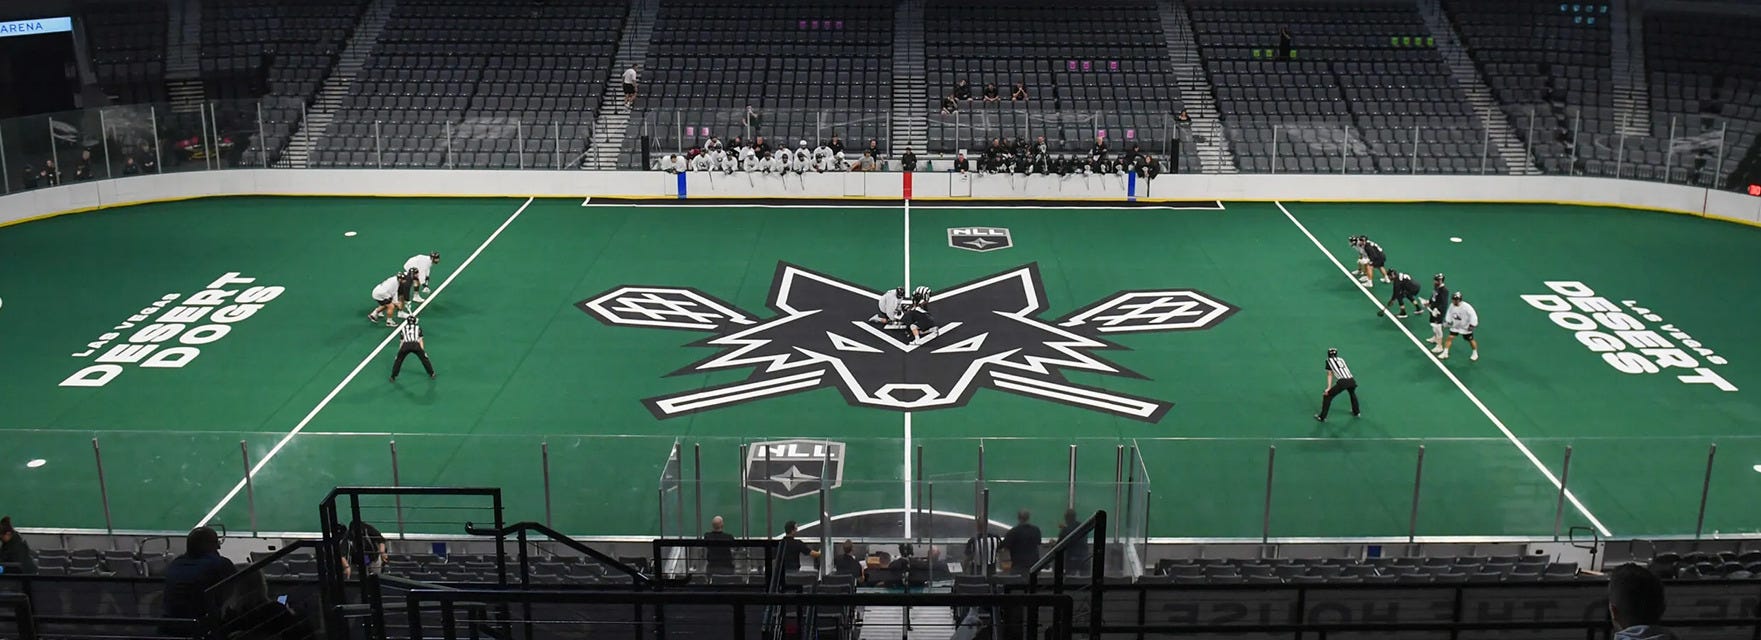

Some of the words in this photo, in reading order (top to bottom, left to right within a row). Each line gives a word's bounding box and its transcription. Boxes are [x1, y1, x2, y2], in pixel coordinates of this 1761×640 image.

[1, 22, 43, 33] ARENA
[58, 272, 256, 387] DESERT
[72, 332, 120, 357] LAS
[114, 293, 181, 330] VEGAS
[139, 286, 285, 369] DOGS
[1520, 294, 1659, 374] DOGS
[1544, 281, 1738, 391] DESERT
[1621, 300, 1663, 322] LAS
[1661, 324, 1728, 364] VEGAS
[758, 444, 835, 457] NLL
